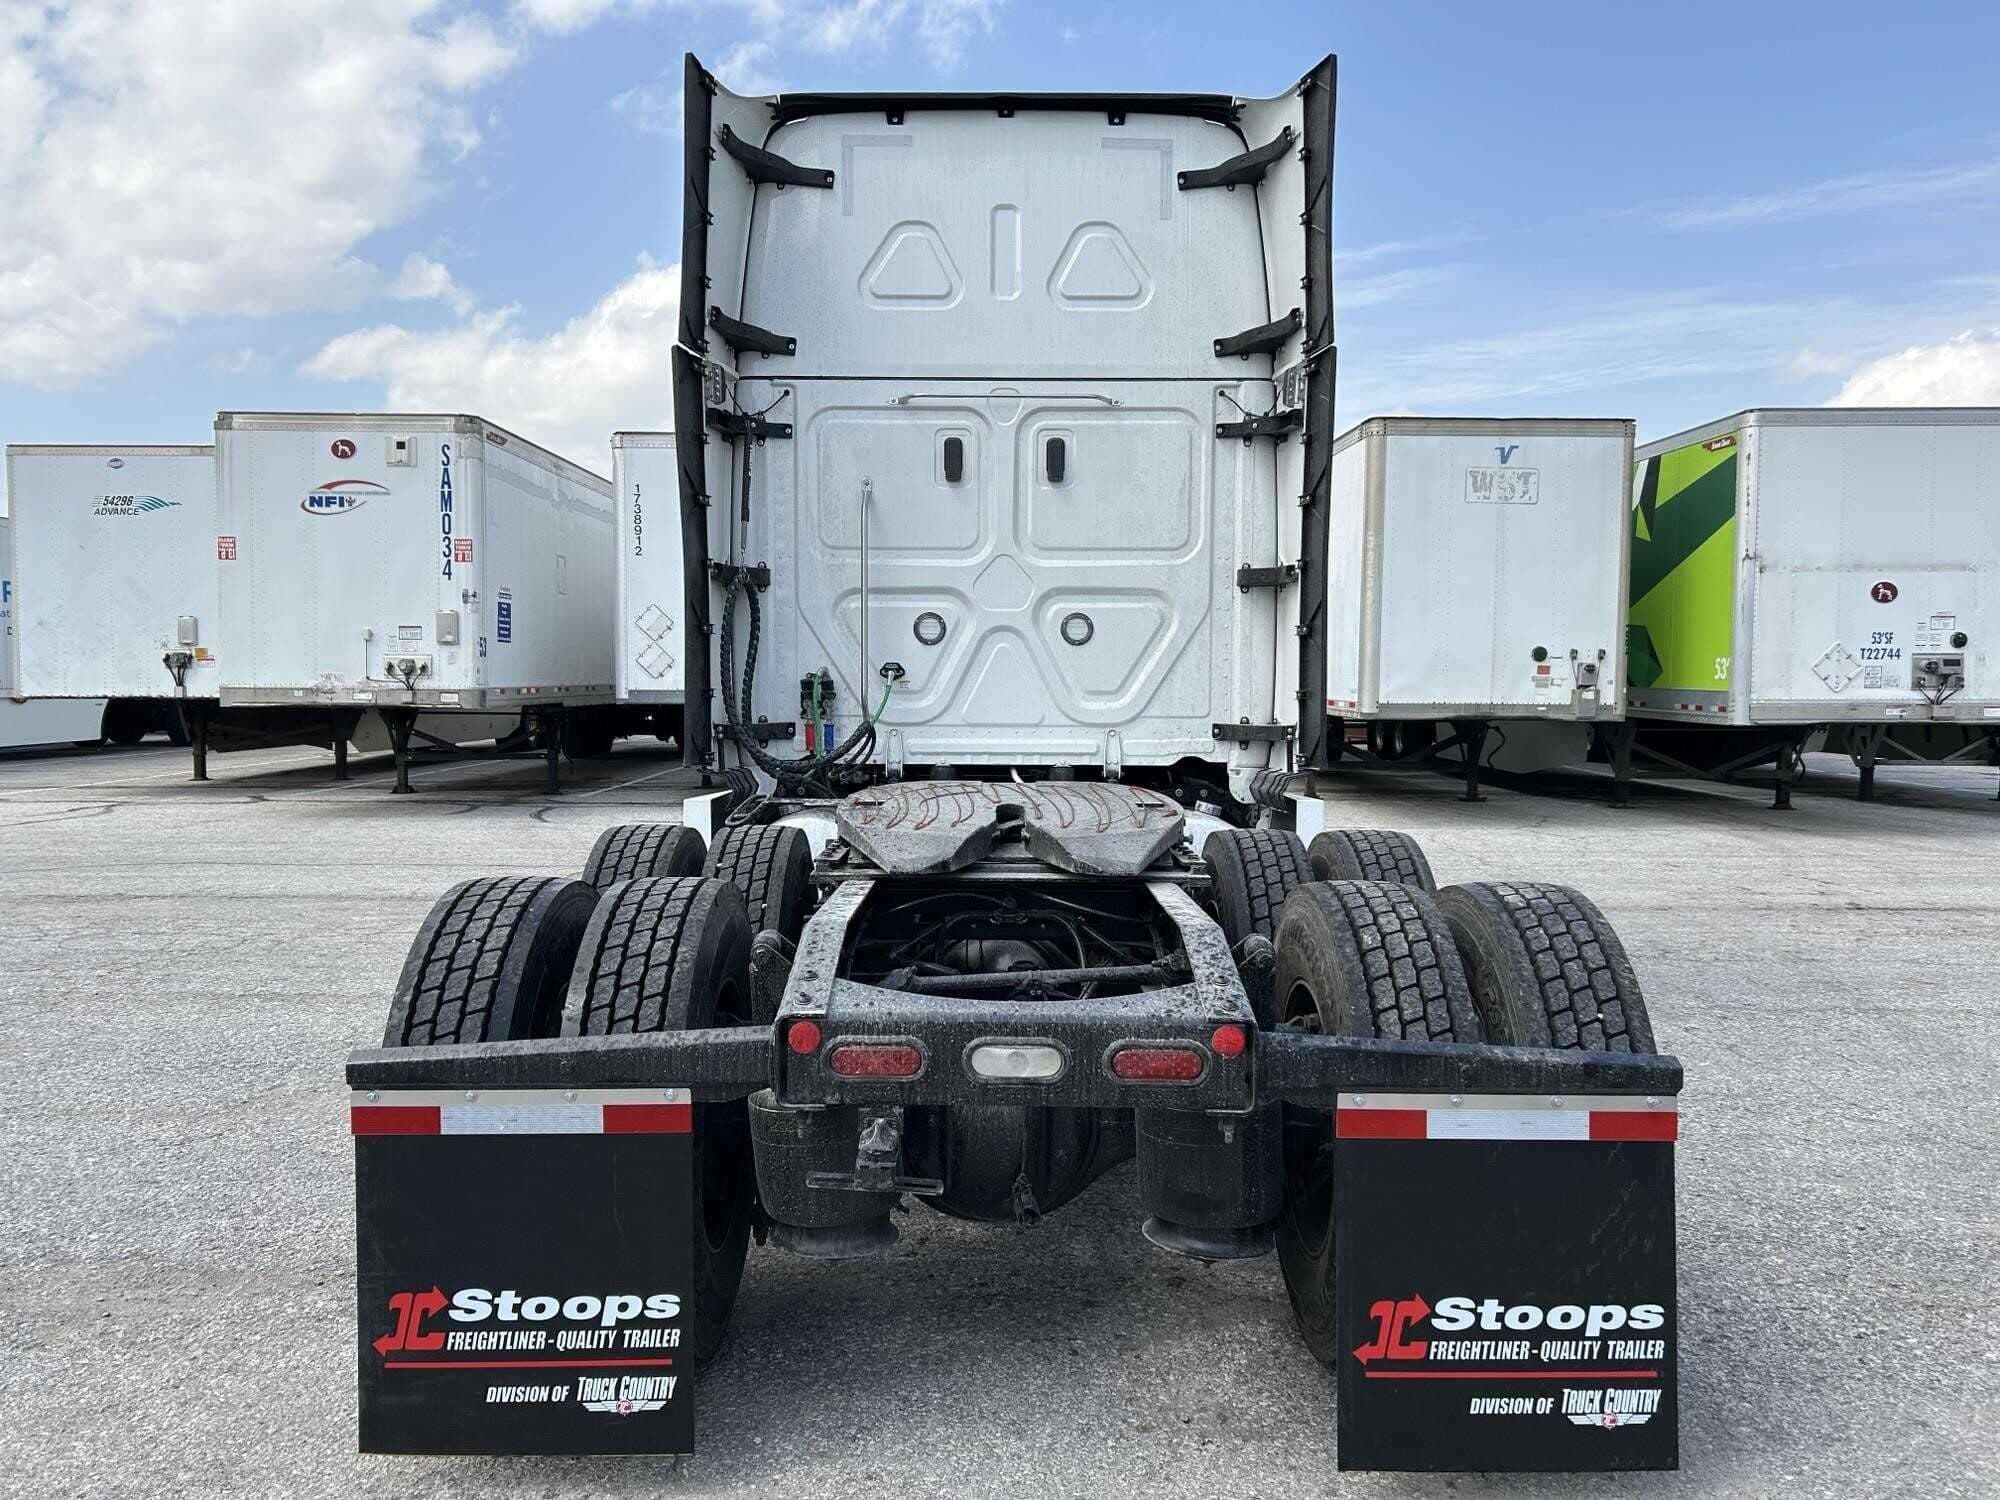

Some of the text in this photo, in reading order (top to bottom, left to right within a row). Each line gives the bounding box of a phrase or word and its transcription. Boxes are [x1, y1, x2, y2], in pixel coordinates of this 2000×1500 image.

[102, 495, 134, 506] 54296
[309, 495, 345, 507] NFI
[93, 507, 140, 516] ADVANCE
[633, 483, 643, 556] 1738912
[1860, 648, 1901, 660] T22744
[448, 1288, 681, 1327] Stoops
[1430, 1296, 1665, 1337] Stoops
[623, 1328, 681, 1349] TRAILER
[1607, 1339, 1665, 1360] TRAILER
[485, 1375, 678, 1403] DIVISION OF TRUCK COUNTRY
[1469, 1388, 1662, 1415] DIVISION OF TRUCK COUNTRY
